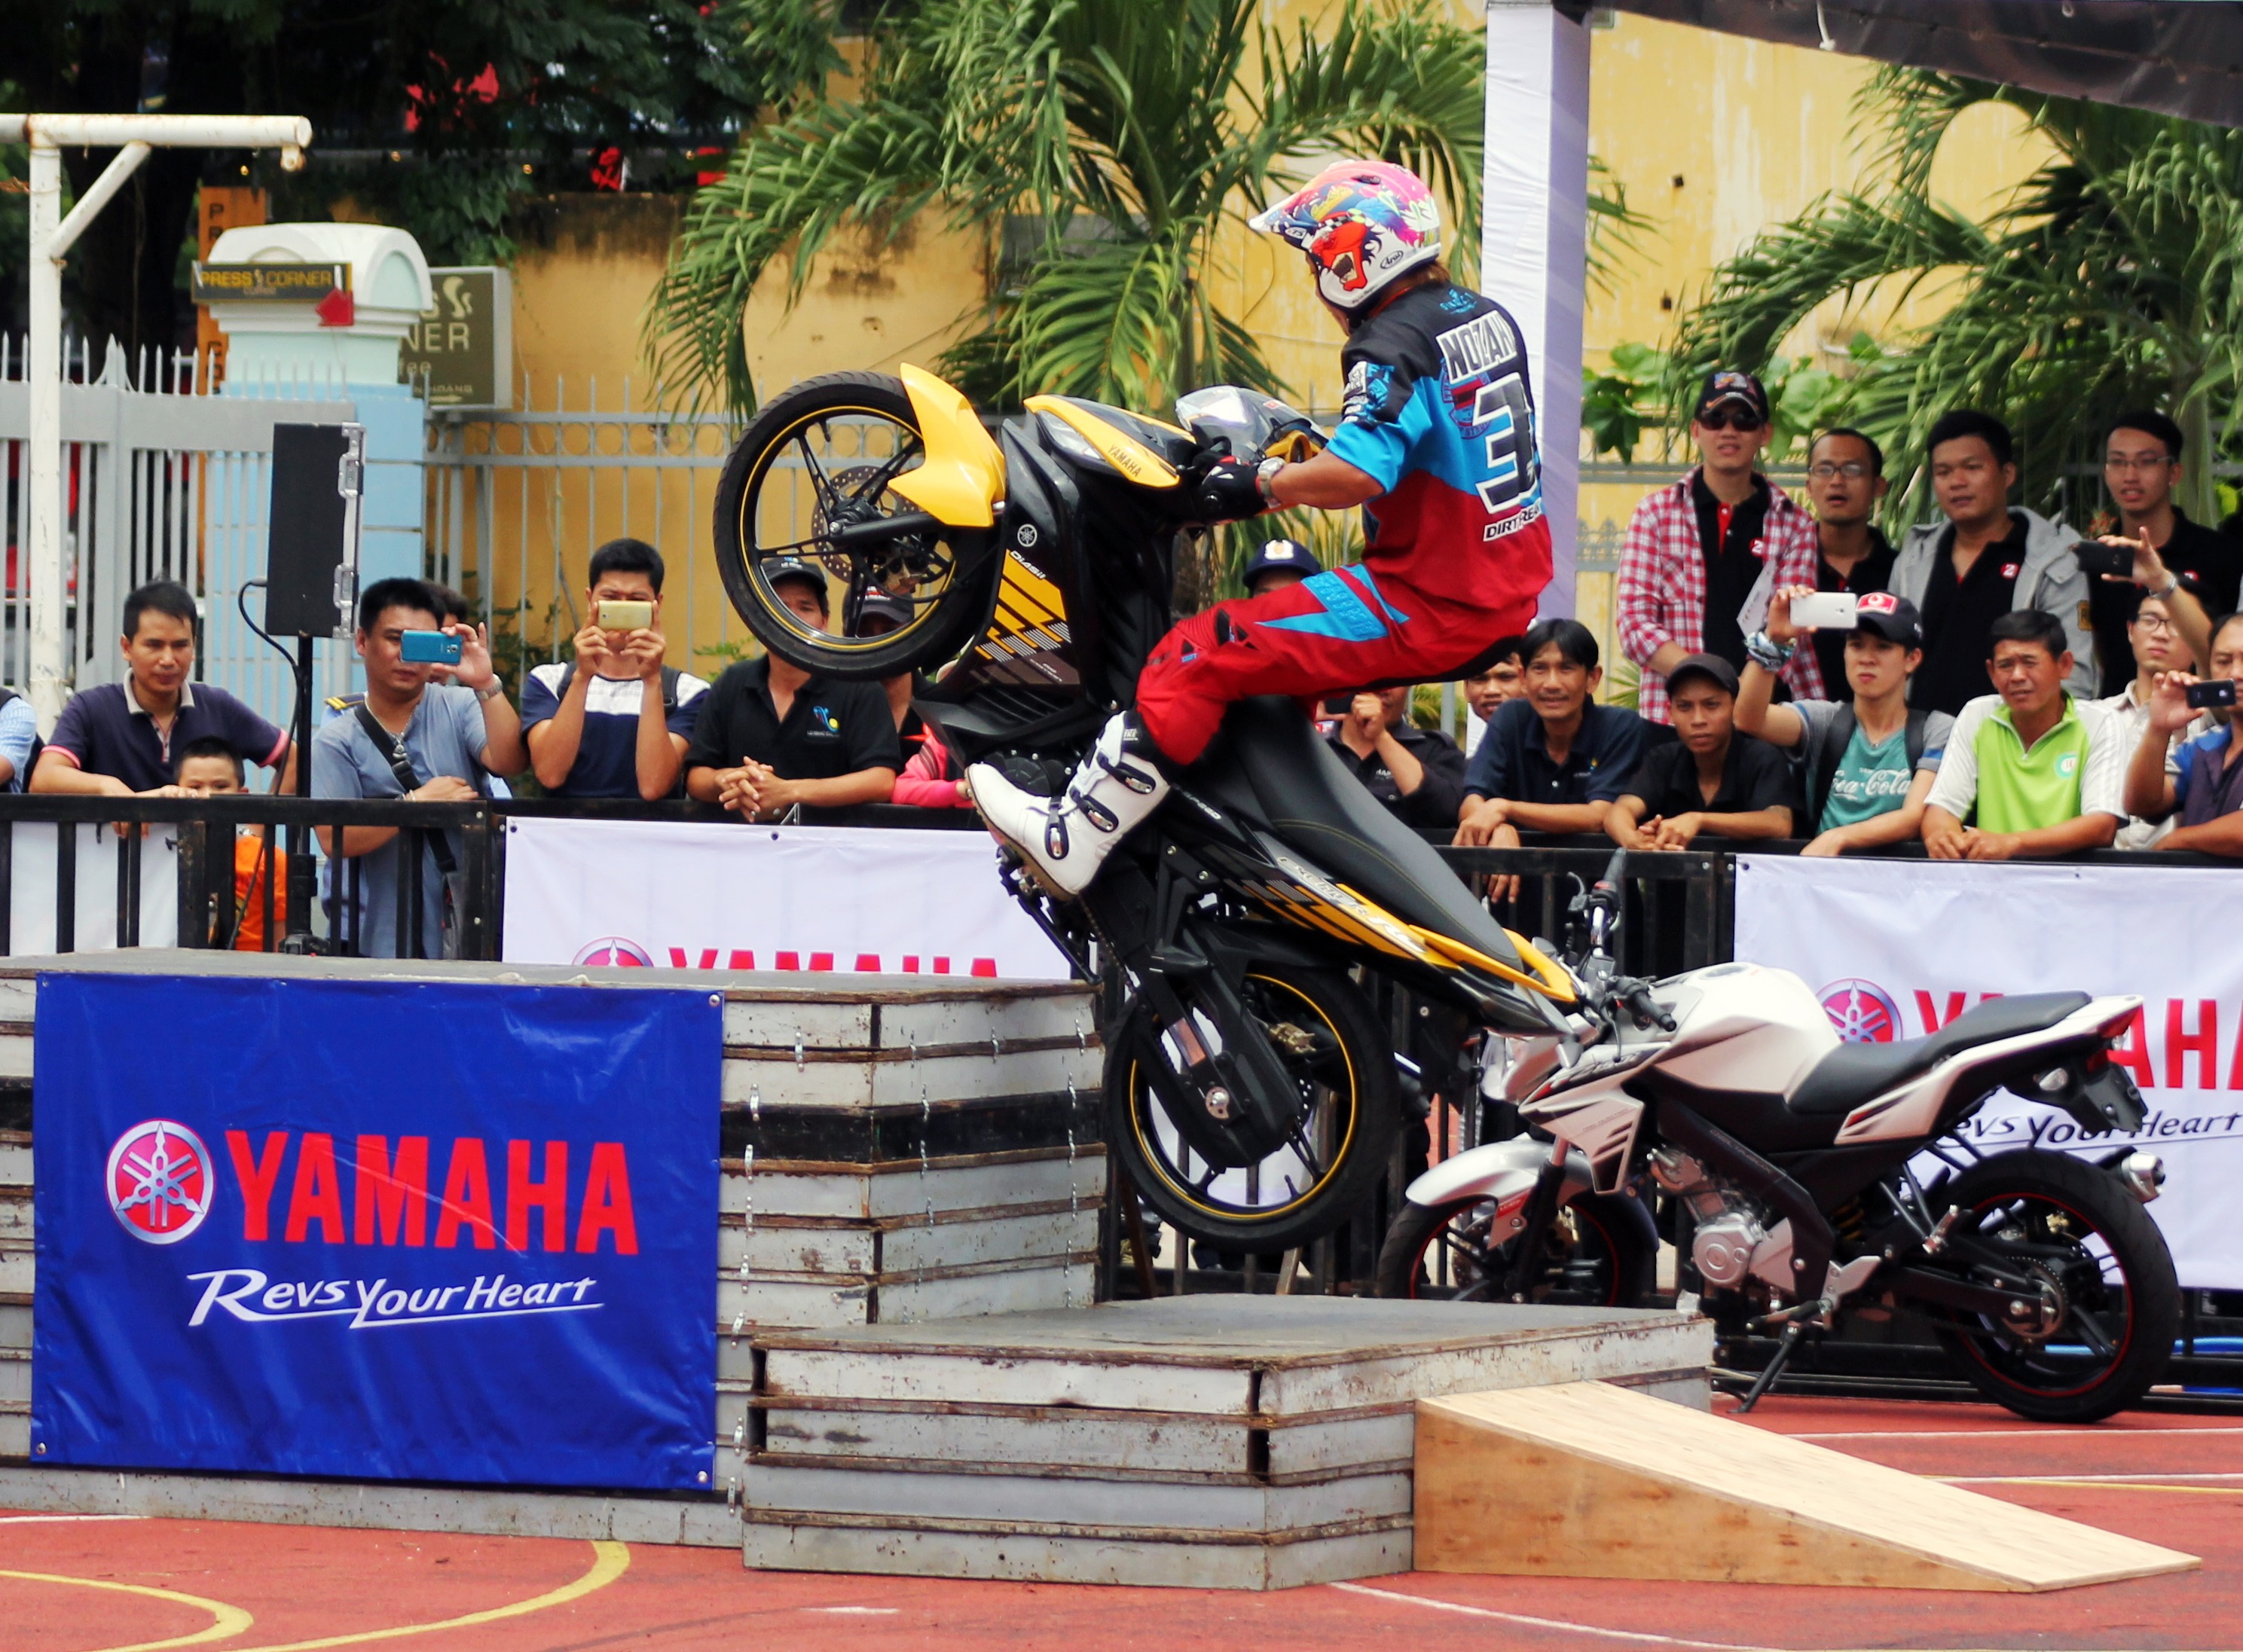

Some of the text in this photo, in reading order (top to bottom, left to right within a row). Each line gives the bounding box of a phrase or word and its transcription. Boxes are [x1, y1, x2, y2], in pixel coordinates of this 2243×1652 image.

[200, 270, 332, 288] PRESS CORNER
[1107, 443, 1142, 478] YAMAHA
[1472, 372, 1538, 515] 3
[226, 1130, 639, 1255] YAMAHA
[187, 1269, 597, 1329] Revs Your Heart
